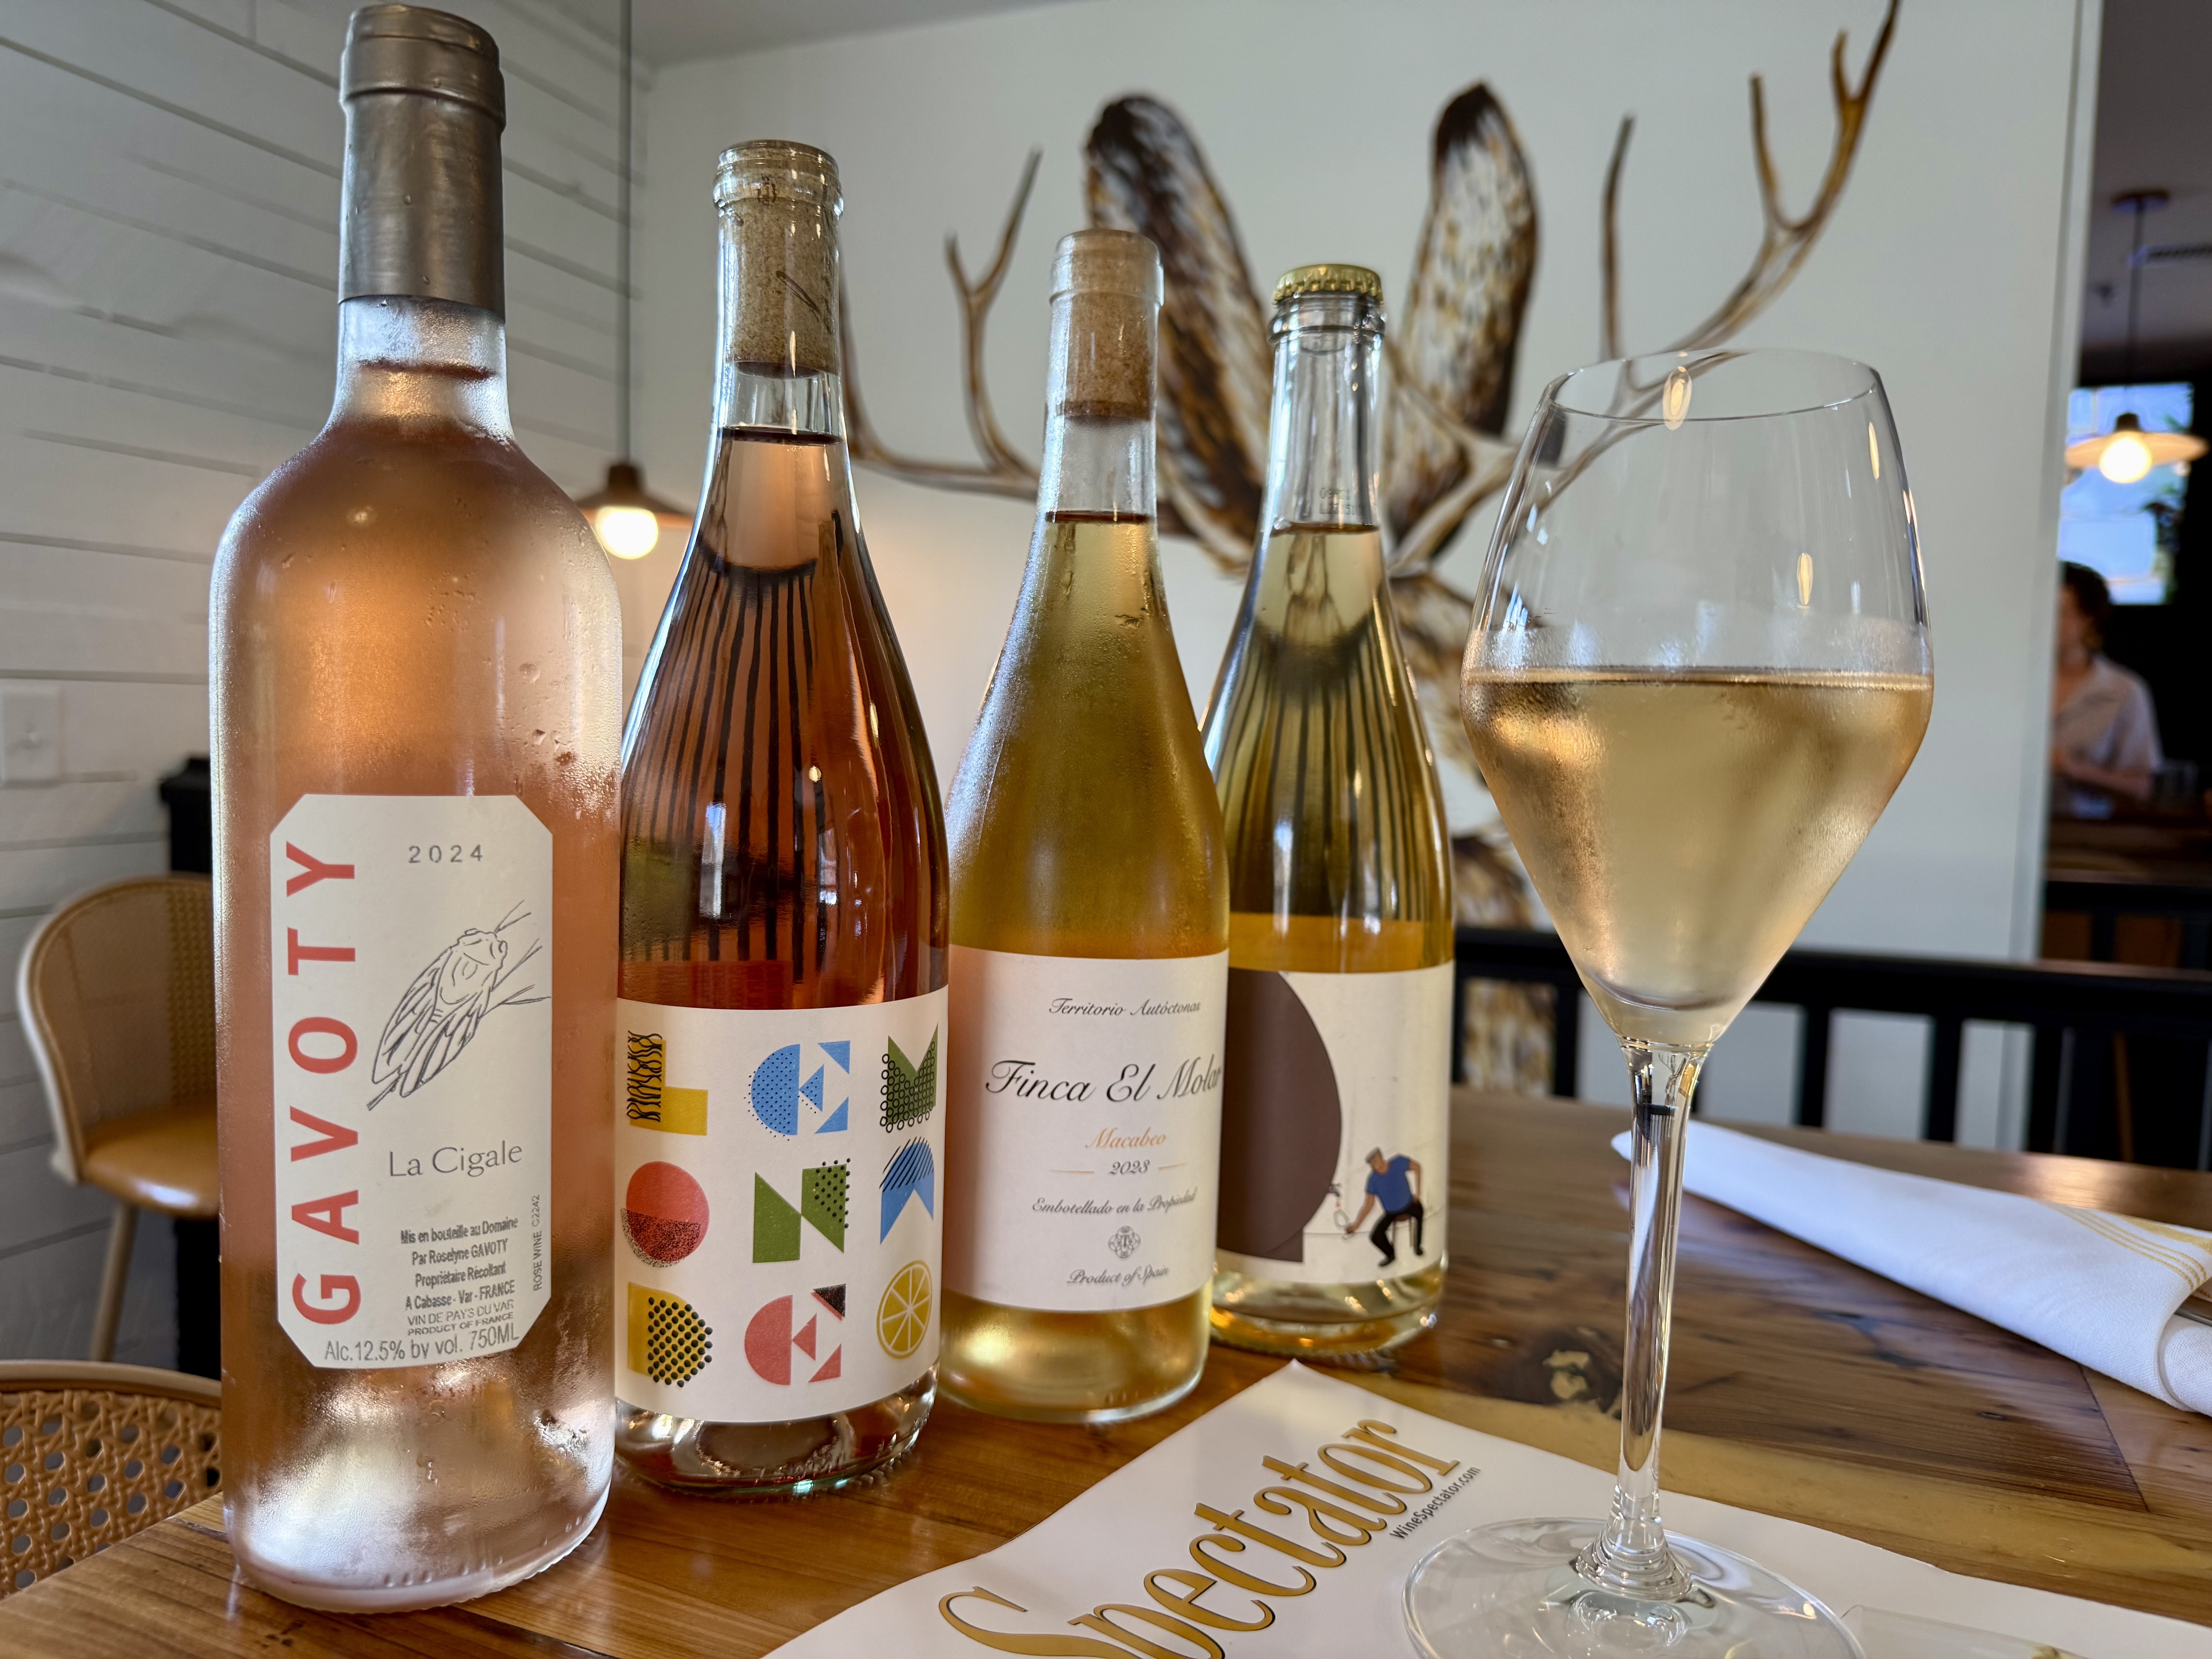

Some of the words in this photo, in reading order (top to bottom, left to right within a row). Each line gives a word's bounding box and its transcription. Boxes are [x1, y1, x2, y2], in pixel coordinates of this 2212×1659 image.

[409, 845, 483, 863] 2024
[1049, 998, 1125, 1015] Territorio
[1130, 999, 1201, 1015] Autóctonas
[286, 841, 361, 1325] GAVOTY
[986, 1060, 1096, 1102] Finca
[1106, 1063, 1156, 1103] El
[1085, 1127, 1166, 1149] Macabeo
[390, 1151, 423, 1177] La
[432, 1140, 523, 1177] Cigale
[1108, 1159, 1151, 1175] 2023
[1032, 1197, 1113, 1214] Embotellado
[1116, 1205, 1129, 1214] en
[1133, 1198, 1144, 1212] la
[401, 1229, 416, 1244] Mis
[418, 1231, 429, 1242] en
[431, 1224, 468, 1241] bouteille
[470, 1225, 481, 1236] au
[483, 1217, 518, 1234] Domaine
[412, 1251, 428, 1265] Par
[429, 1248, 469, 1264] Roselyne
[471, 1238, 508, 1258] GAVOTY
[533, 1230, 542, 1260] WINE
[533, 1260, 542, 1291] ROSE
[1067, 1269, 1120, 1284] Product
[1122, 1266, 1141, 1286] of
[1138, 1264, 1170, 1286] Spain
[415, 1295, 452, 1309] Cabasse
[458, 1290, 473, 1304] Var
[479, 1279, 515, 1300] FRANCE
[408, 1315, 426, 1326] VIN
[429, 1312, 443, 1323] DE
[447, 1308, 475, 1321] PAYS
[477, 1305, 491, 1316] DU
[493, 1299, 514, 1312] VAR
[408, 1323, 457, 1336] PRODUCT
[460, 1321, 473, 1329] OF
[476, 1312, 514, 1326] FRANCE
[410, 1340, 429, 1359] by
[435, 1334, 463, 1355] vol.
[469, 1322, 520, 1350] 750ML
[1389, 1467, 1481, 1539] WineSpectator.com
